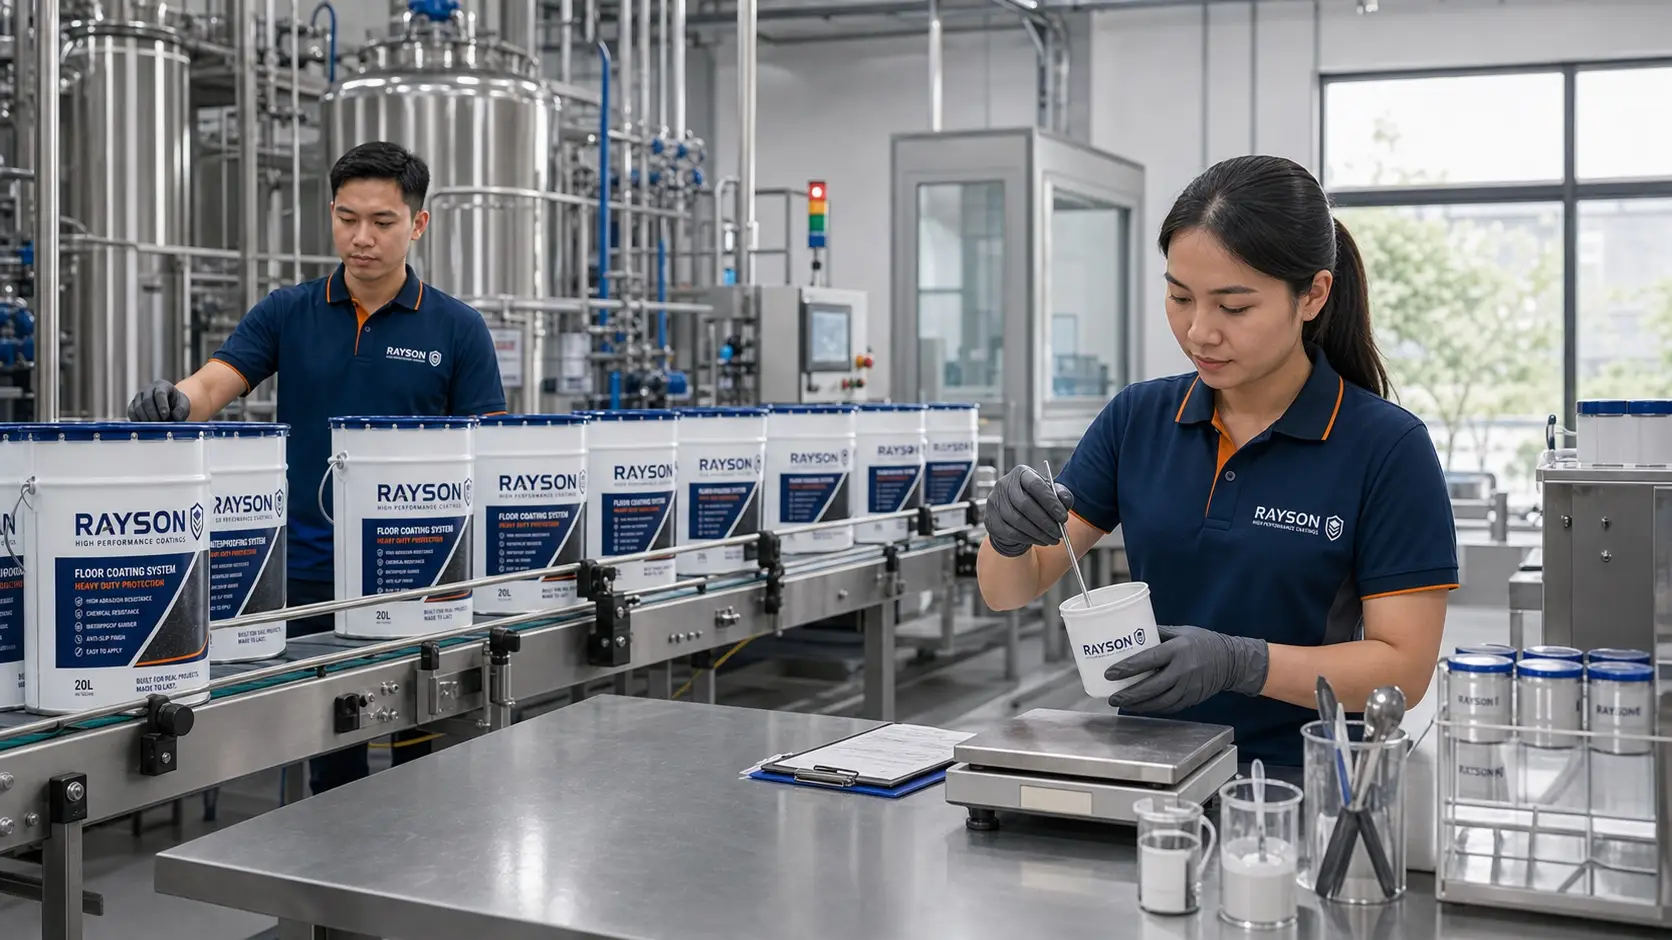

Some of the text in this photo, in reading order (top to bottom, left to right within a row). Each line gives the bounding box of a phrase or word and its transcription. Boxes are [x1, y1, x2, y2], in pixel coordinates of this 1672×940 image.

[386, 346, 426, 359] RAYSON
[699, 457, 752, 471] RAYSON
[790, 452, 838, 464] RAYSON
[614, 463, 673, 480] RAYSON
[499, 474, 577, 491] RAYSON
[377, 482, 462, 502] RAYSON
[520, 512, 547, 520] COATING
[1254, 506, 1321, 529] RAYSON
[75, 510, 186, 536] RAYSON
[377, 524, 454, 535] FLOOR COATING SYSTEM
[97, 538, 153, 547] PERFORMANCE
[156, 536, 187, 545] COATINGS
[75, 564, 176, 578] FLOOR COATING SYSTEM
[75, 579, 165, 590] HEAVY DUTY PROTECTION
[497, 588, 511, 597] 20L
[376, 610, 391, 620] 20L
[1082, 634, 1133, 656] RAYSON
[75, 679, 93, 691] 20L
[136, 676, 152, 685] BUILT
[136, 685, 154, 693] MADE
[154, 684, 162, 692] TO
